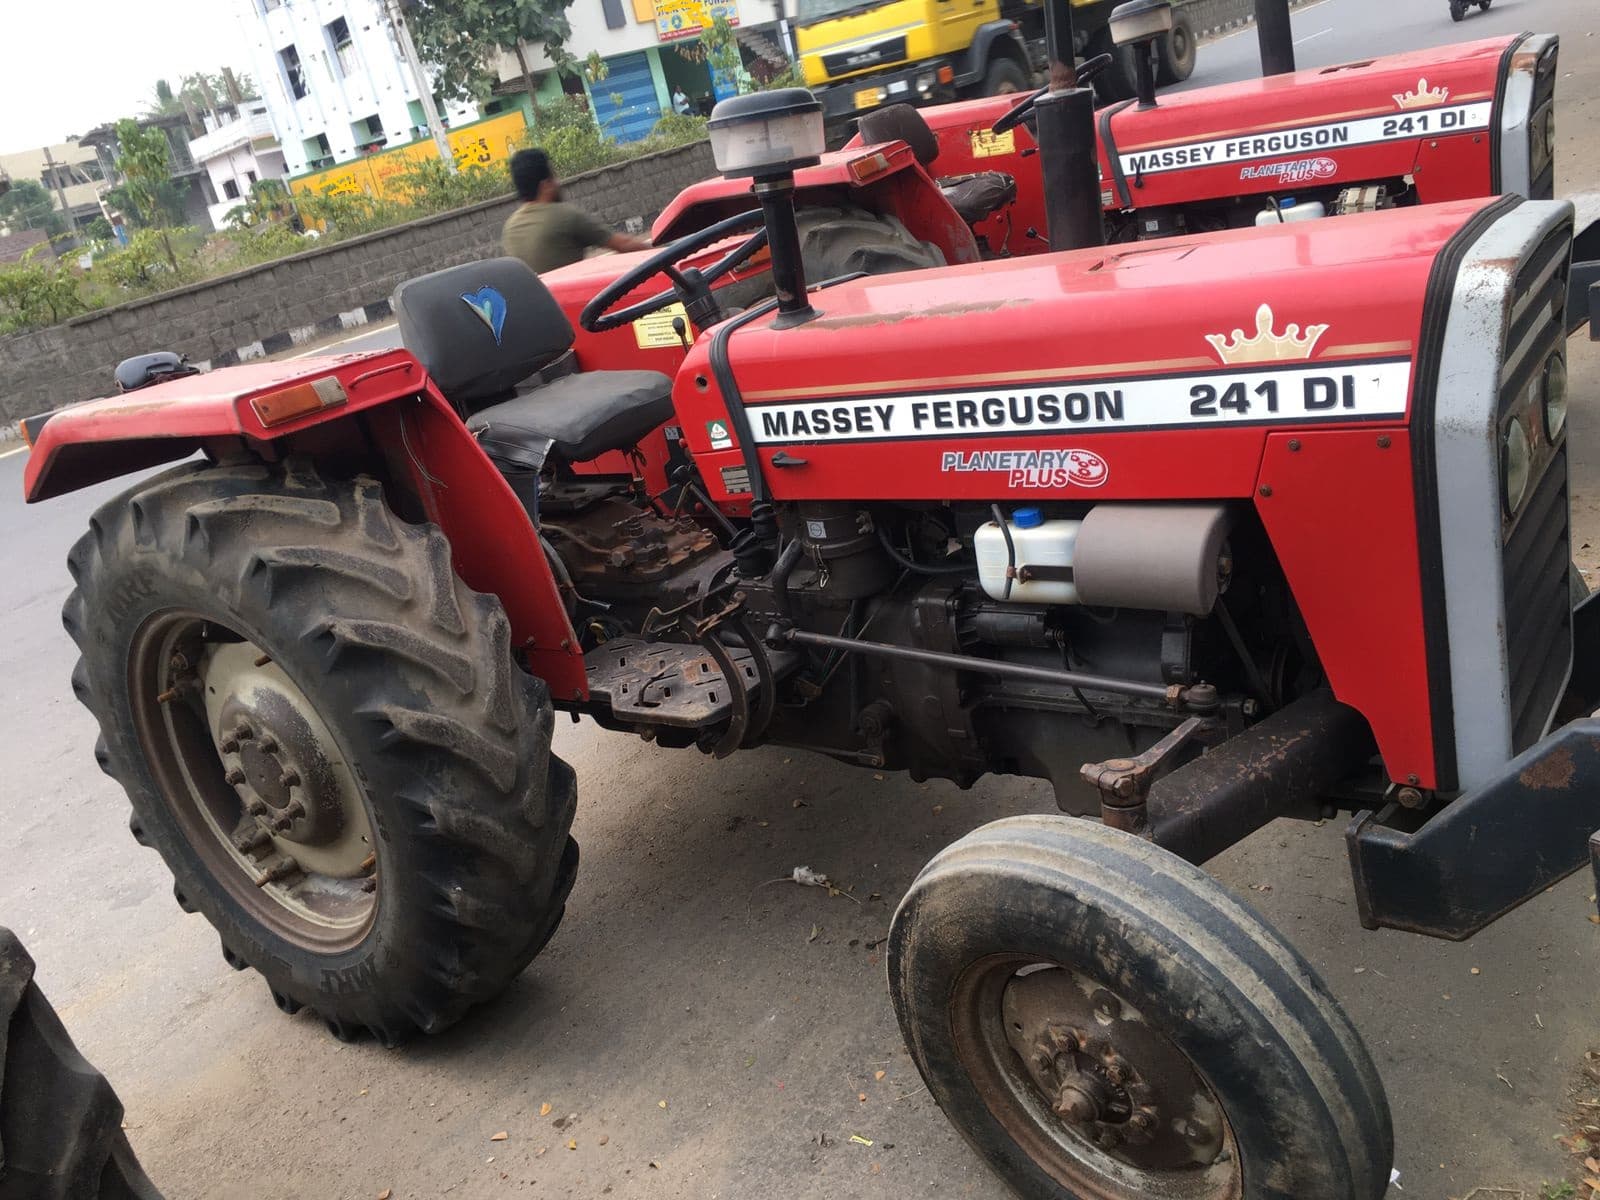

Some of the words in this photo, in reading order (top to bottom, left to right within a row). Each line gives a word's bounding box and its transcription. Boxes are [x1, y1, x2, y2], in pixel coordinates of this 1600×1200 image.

[1130, 146, 1215, 172] MASSEY
[1226, 127, 1349, 158] FERGUSON
[1383, 115, 1428, 136] 241
[1440, 110, 1465, 128] DI
[1241, 159, 1317, 179] PLANETARY
[1279, 169, 1315, 183] PLUS
[762, 405, 894, 436] MASSEY
[912, 390, 1124, 430] FERGUSON
[1190, 380, 1279, 416] 241
[1303, 375, 1355, 410] DI
[942, 450, 1070, 471] PLANETARY
[1009, 468, 1069, 487] PLUS
